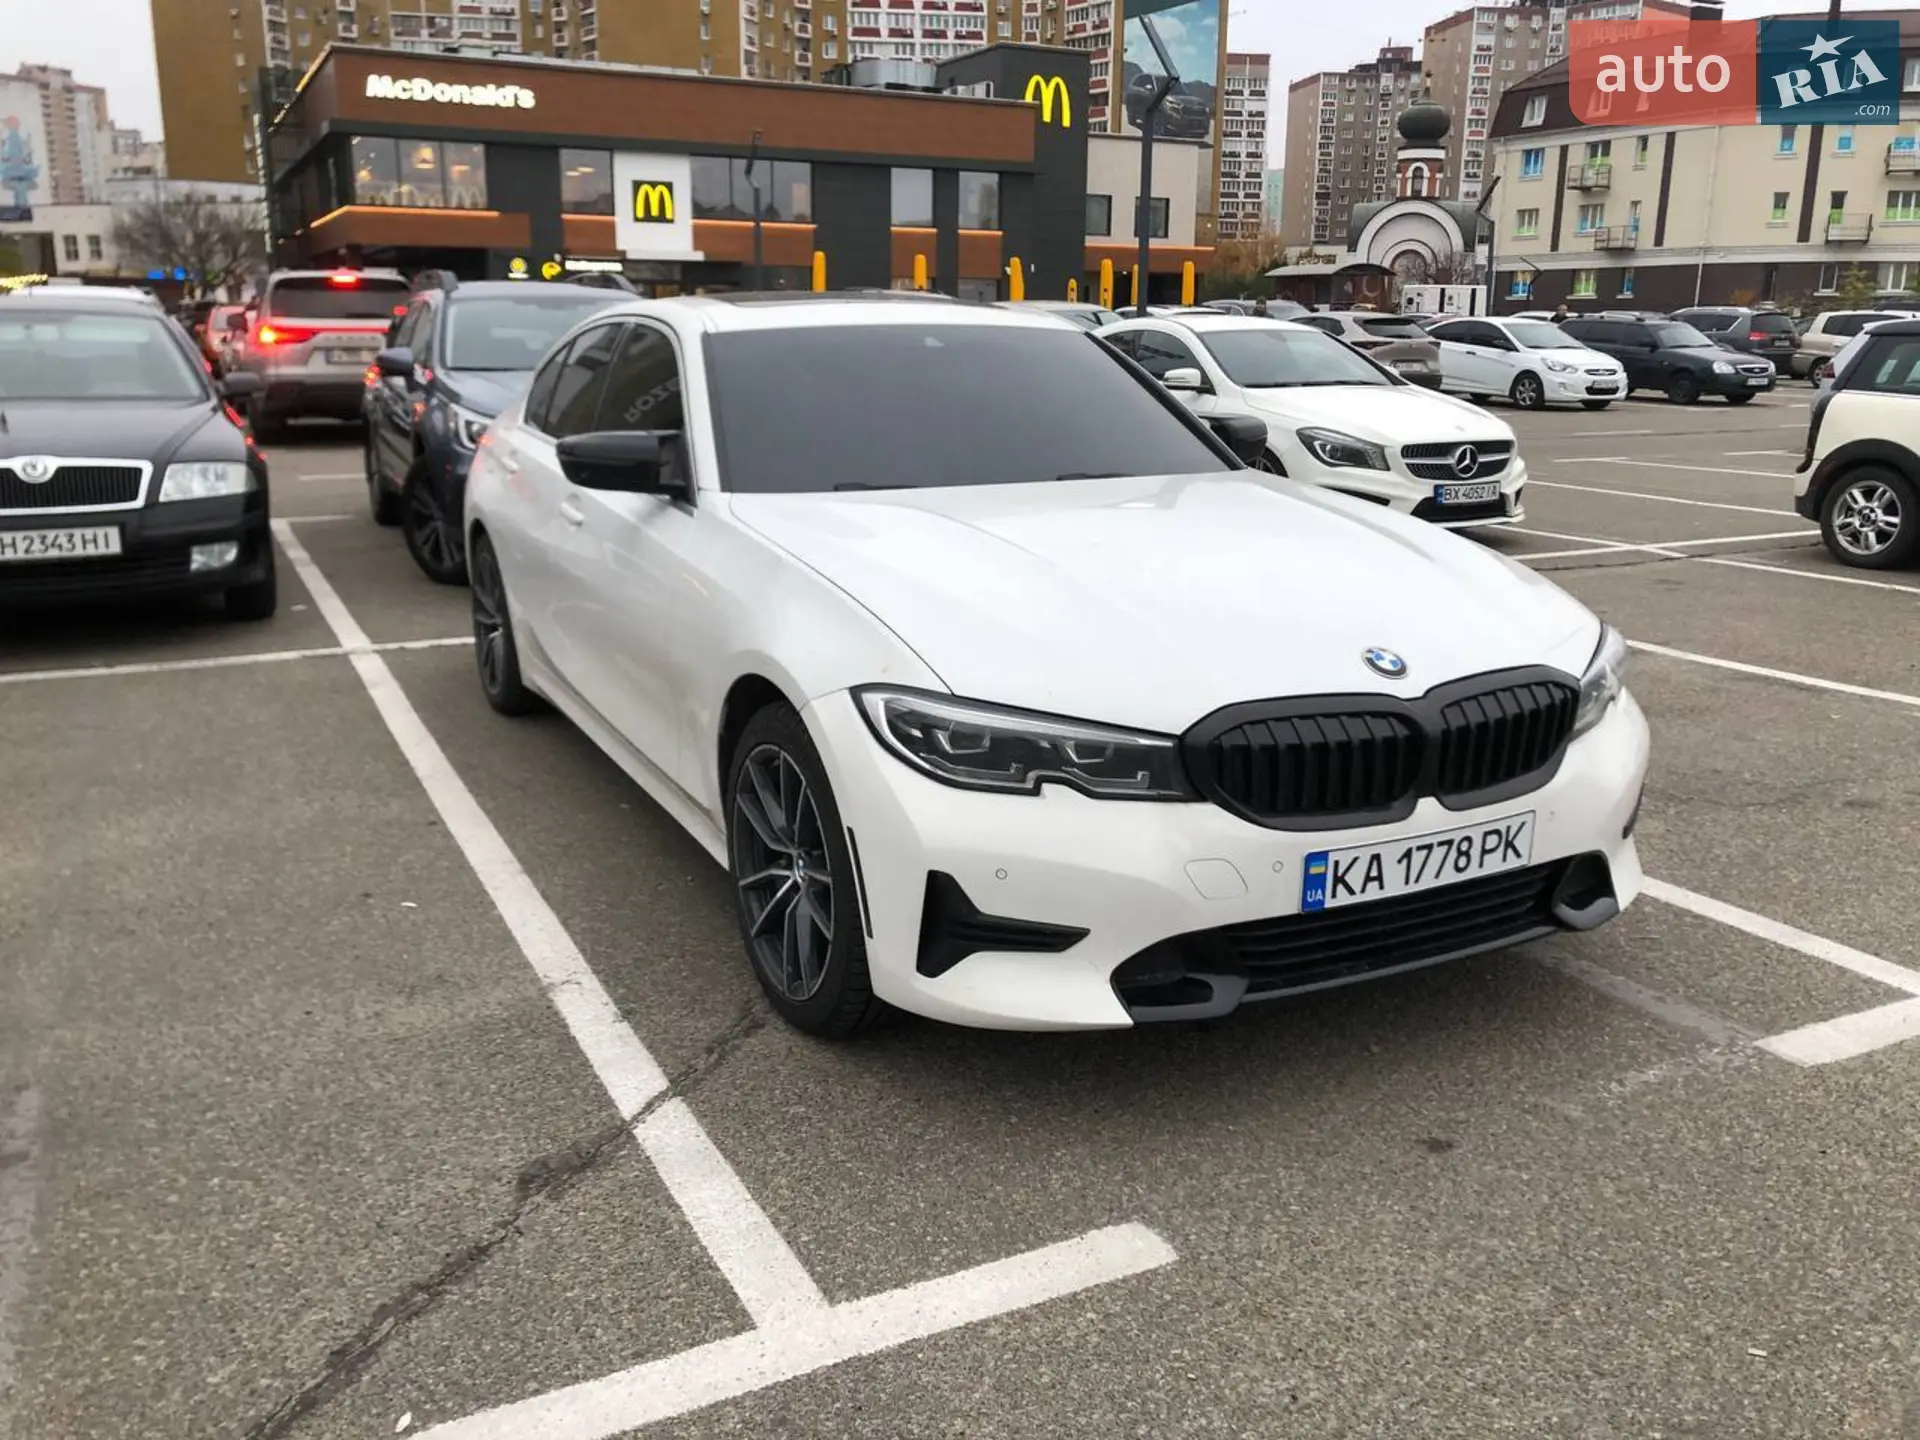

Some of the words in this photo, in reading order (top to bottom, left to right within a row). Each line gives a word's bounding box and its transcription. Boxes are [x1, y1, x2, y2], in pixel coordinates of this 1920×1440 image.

[366, 74, 536, 109] McDonald's
[22, 532, 76, 555] 2343
[1330, 852, 1385, 899] KA
[1396, 835, 1473, 886] 1778
[1478, 821, 1527, 869] PK
[1307, 888, 1324, 902] UA
